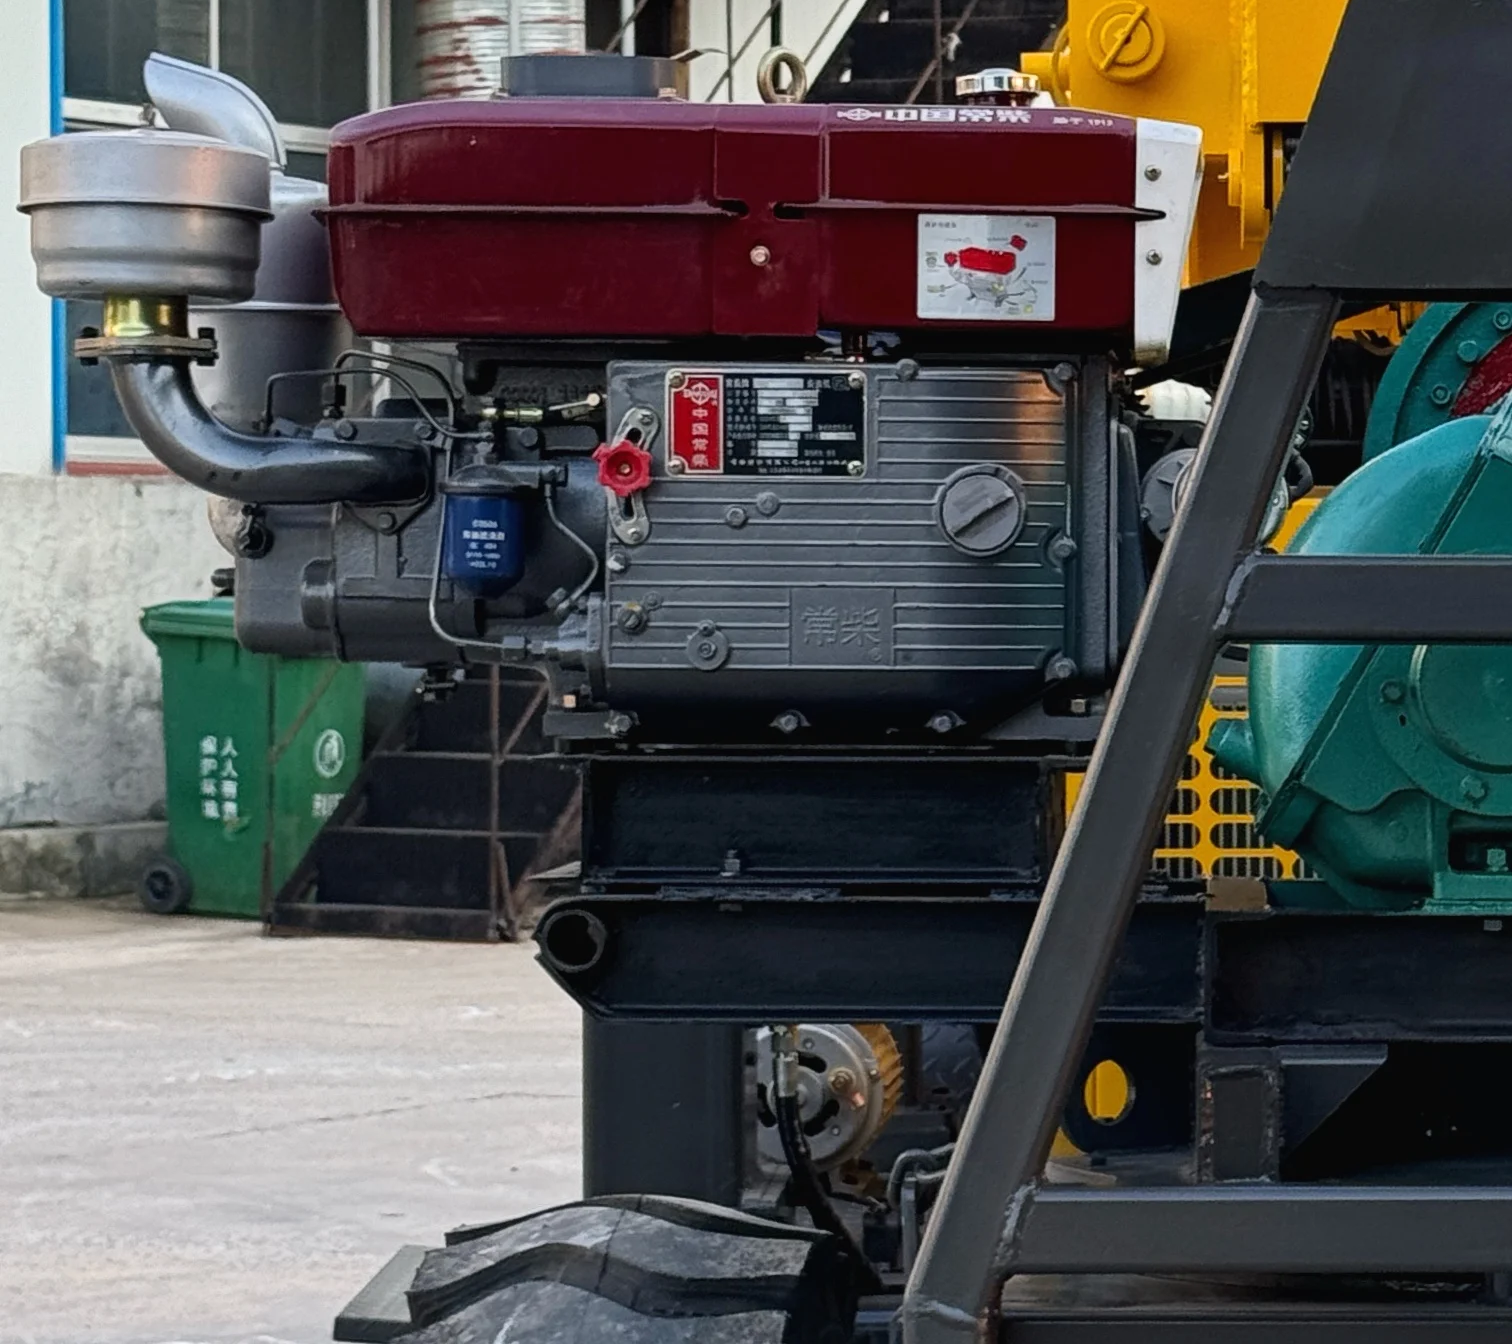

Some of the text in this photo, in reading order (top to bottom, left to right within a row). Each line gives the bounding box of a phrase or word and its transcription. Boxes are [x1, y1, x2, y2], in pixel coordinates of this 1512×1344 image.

[884, 108, 1032, 124] 中国常柴
[800, 606, 881, 647] 常柴
